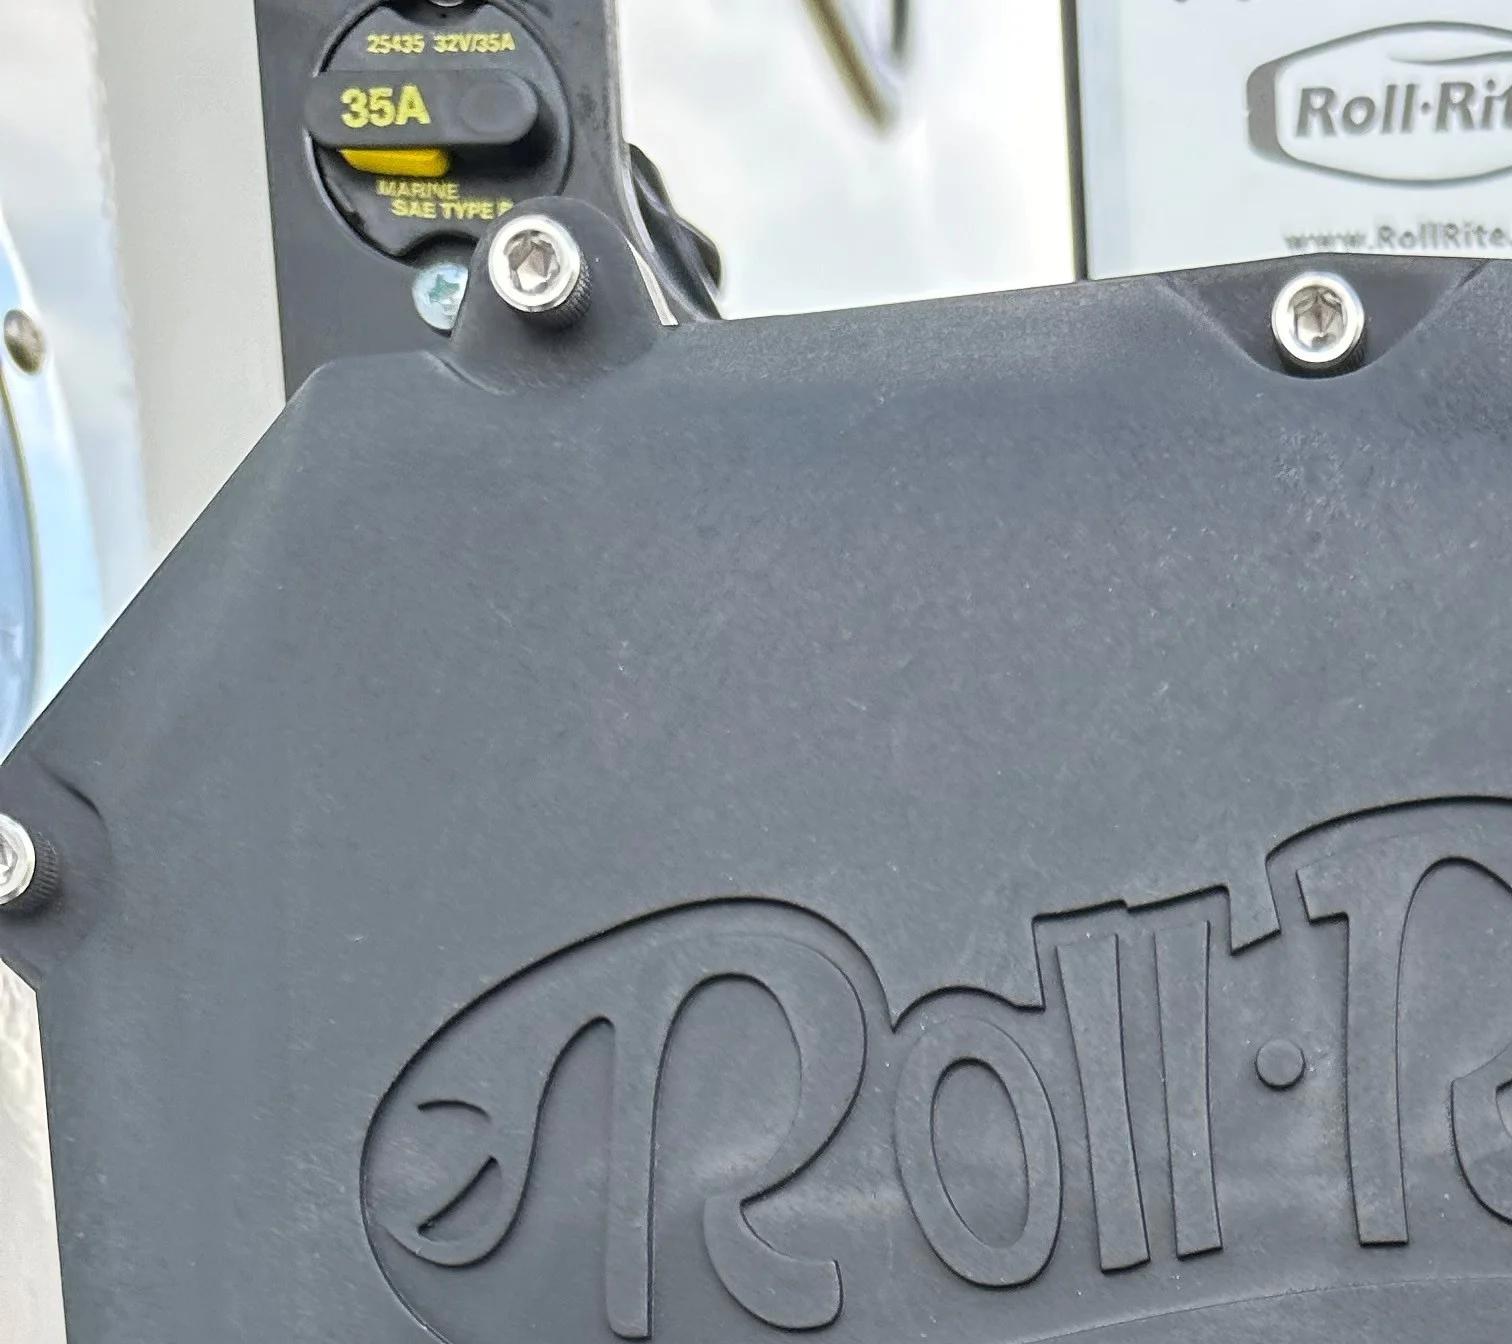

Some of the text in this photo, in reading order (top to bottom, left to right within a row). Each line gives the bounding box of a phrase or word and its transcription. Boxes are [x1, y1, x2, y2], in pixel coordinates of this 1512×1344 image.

[367, 31, 516, 54] 25435 32V/35A
[340, 83, 431, 129] 35A
[376, 181, 460, 200] MARINE
[391, 199, 437, 219] SAE
[440, 200, 494, 220] TYPE
